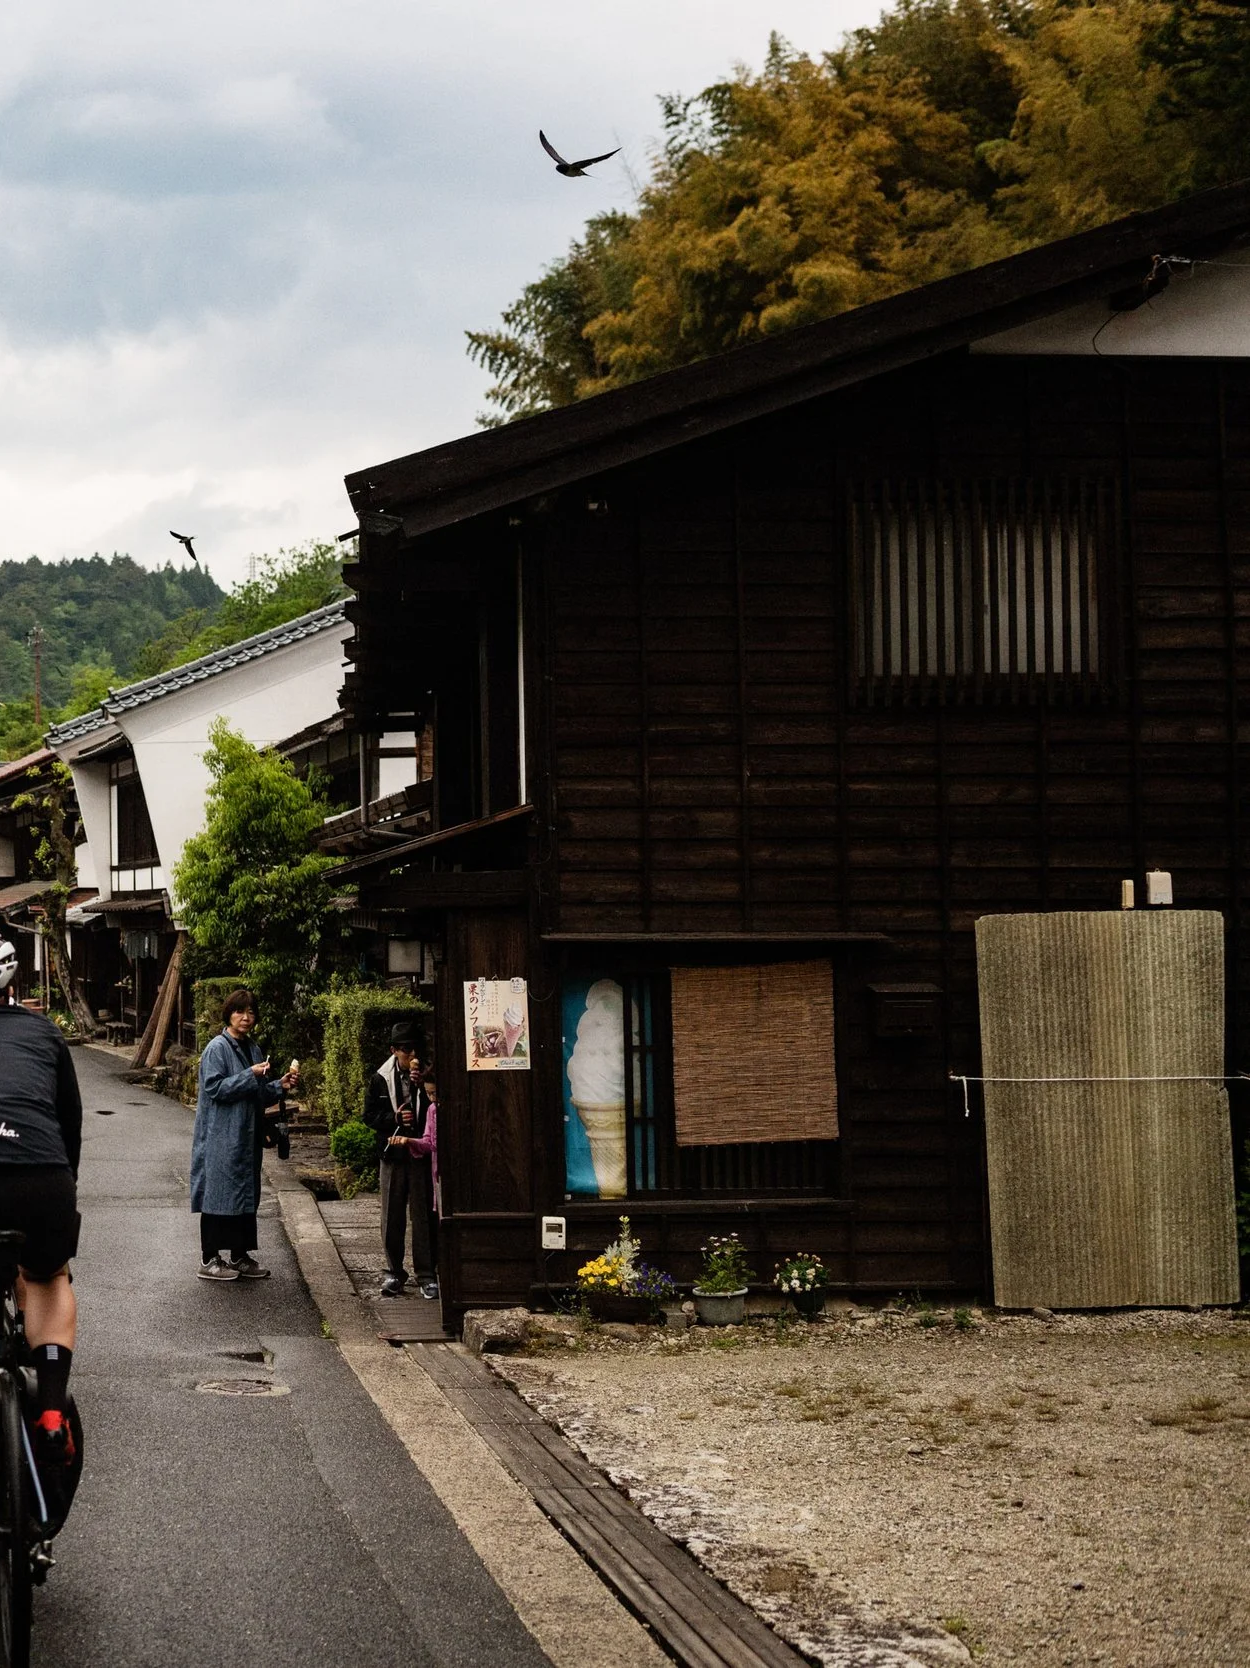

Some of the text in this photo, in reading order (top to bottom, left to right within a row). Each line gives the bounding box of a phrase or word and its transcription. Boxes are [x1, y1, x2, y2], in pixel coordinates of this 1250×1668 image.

[469, 984, 480, 1068] 栗のソフトアイス
